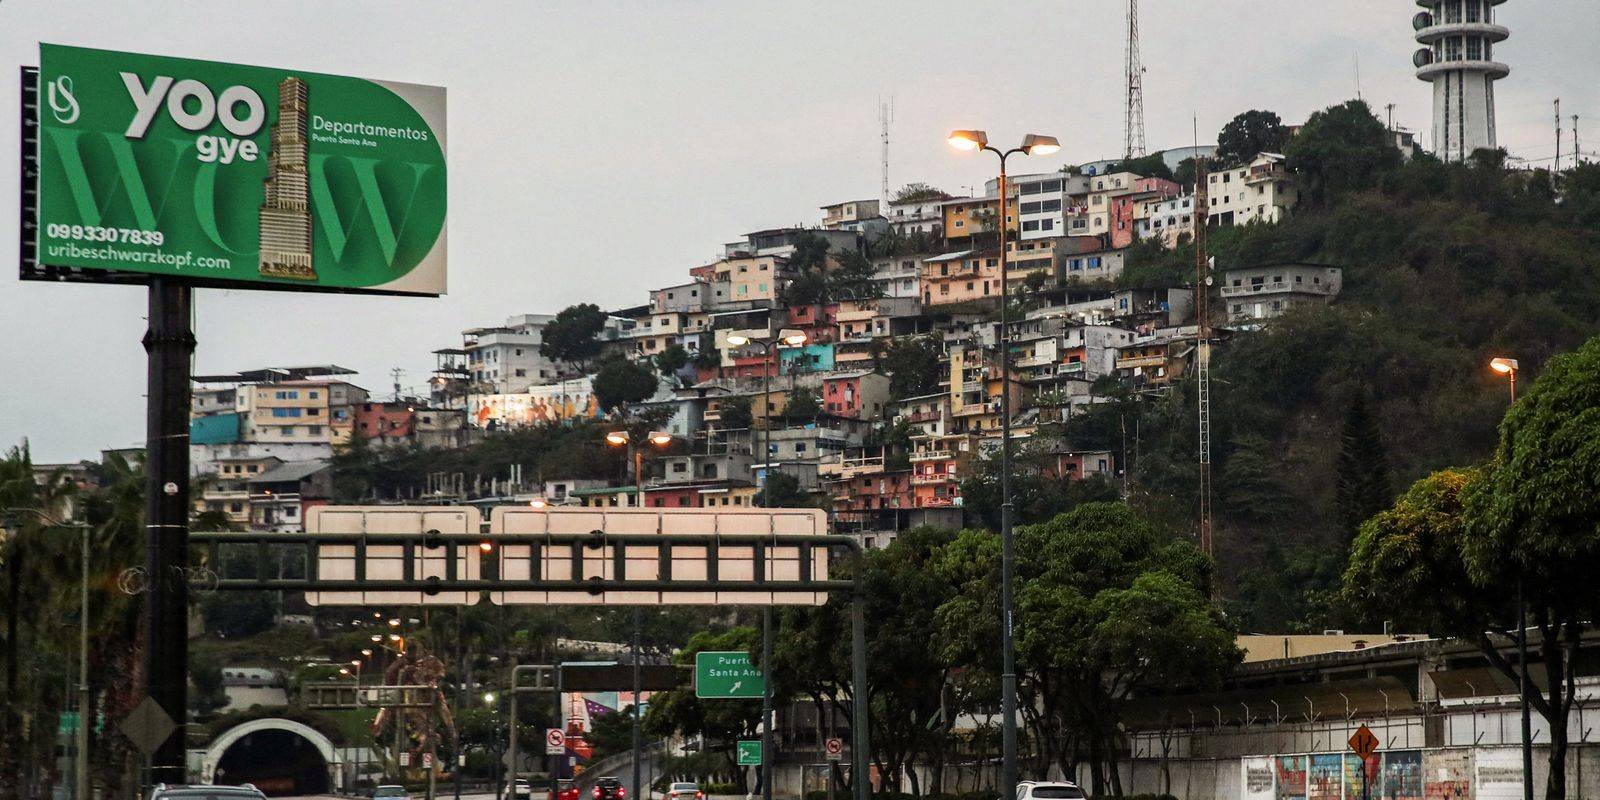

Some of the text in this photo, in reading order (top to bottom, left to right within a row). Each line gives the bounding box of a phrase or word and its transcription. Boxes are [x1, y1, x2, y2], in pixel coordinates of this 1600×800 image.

[119, 71, 266, 138] yoo
[312, 133, 377, 147] Puerto Santa Ana
[313, 115, 428, 141] Departamentos
[196, 134, 259, 165] gye
[47, 223, 164, 246] 0993307839
[49, 243, 231, 269] uribeschwarzkopf.com
[709, 668, 762, 677] Santa Ana
